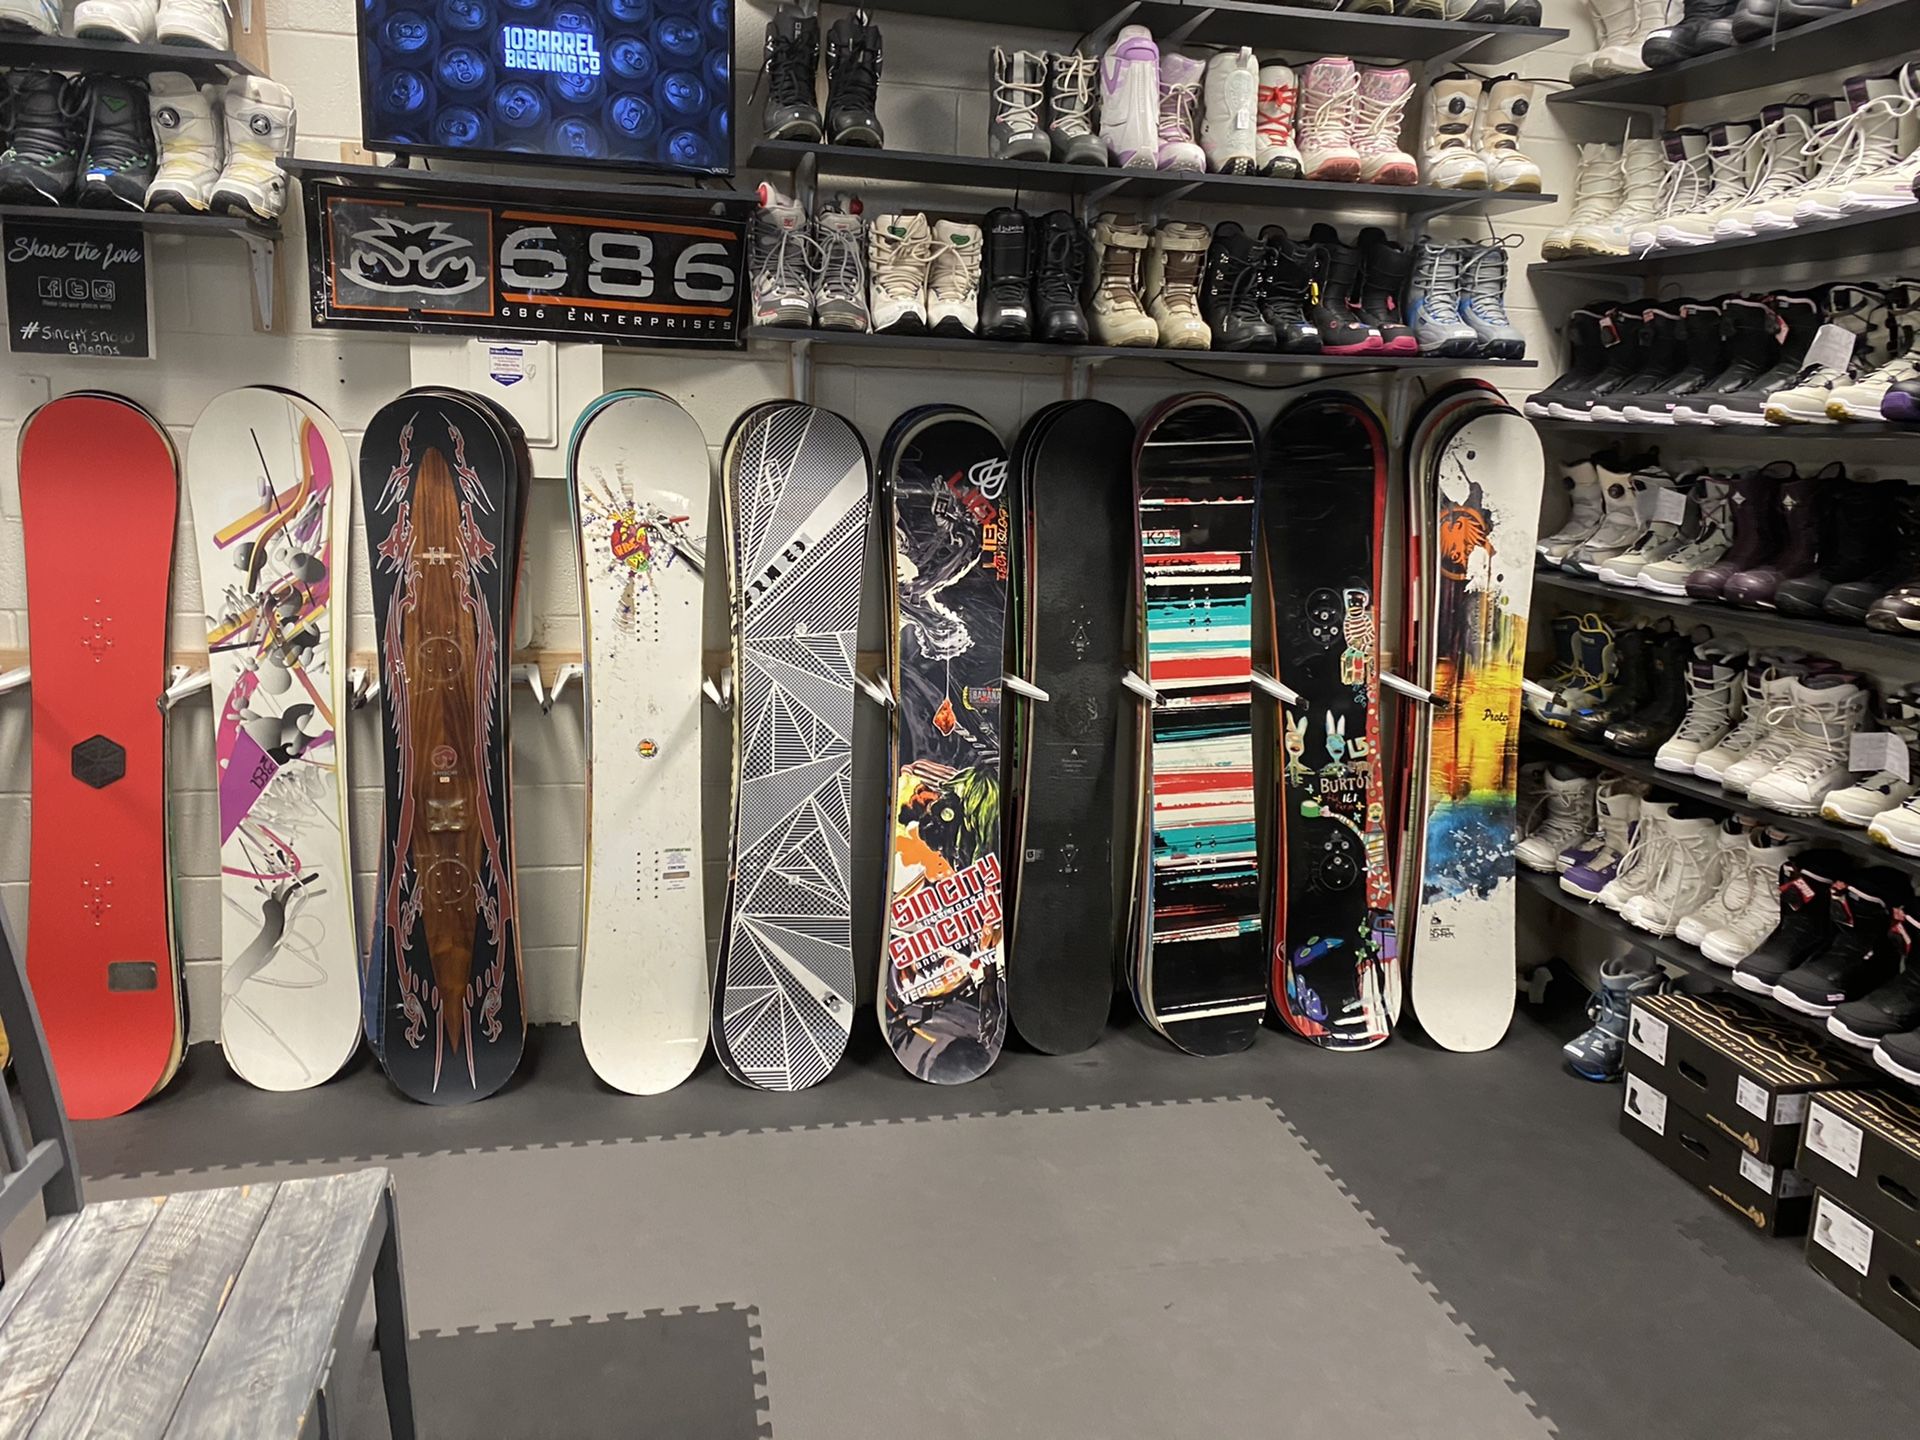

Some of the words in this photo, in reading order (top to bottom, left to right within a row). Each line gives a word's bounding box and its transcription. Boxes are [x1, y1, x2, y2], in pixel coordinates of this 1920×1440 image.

[8, 237, 69, 262] Share
[102, 243, 142, 270] Love
[500, 226, 735, 302] 686
[501, 306, 545, 319] 686
[567, 309, 732, 330] ENTERPRISES
[1147, 531, 1166, 545] K2
[1482, 708, 1508, 722] Proto
[1320, 776, 1374, 794] BURTON
[891, 888, 941, 928] SIN
[937, 853, 1001, 906] CITY
[889, 929, 940, 968] SIN
[936, 894, 1002, 946] CITY
[1669, 1007, 1744, 1053] SNOWBOARD
